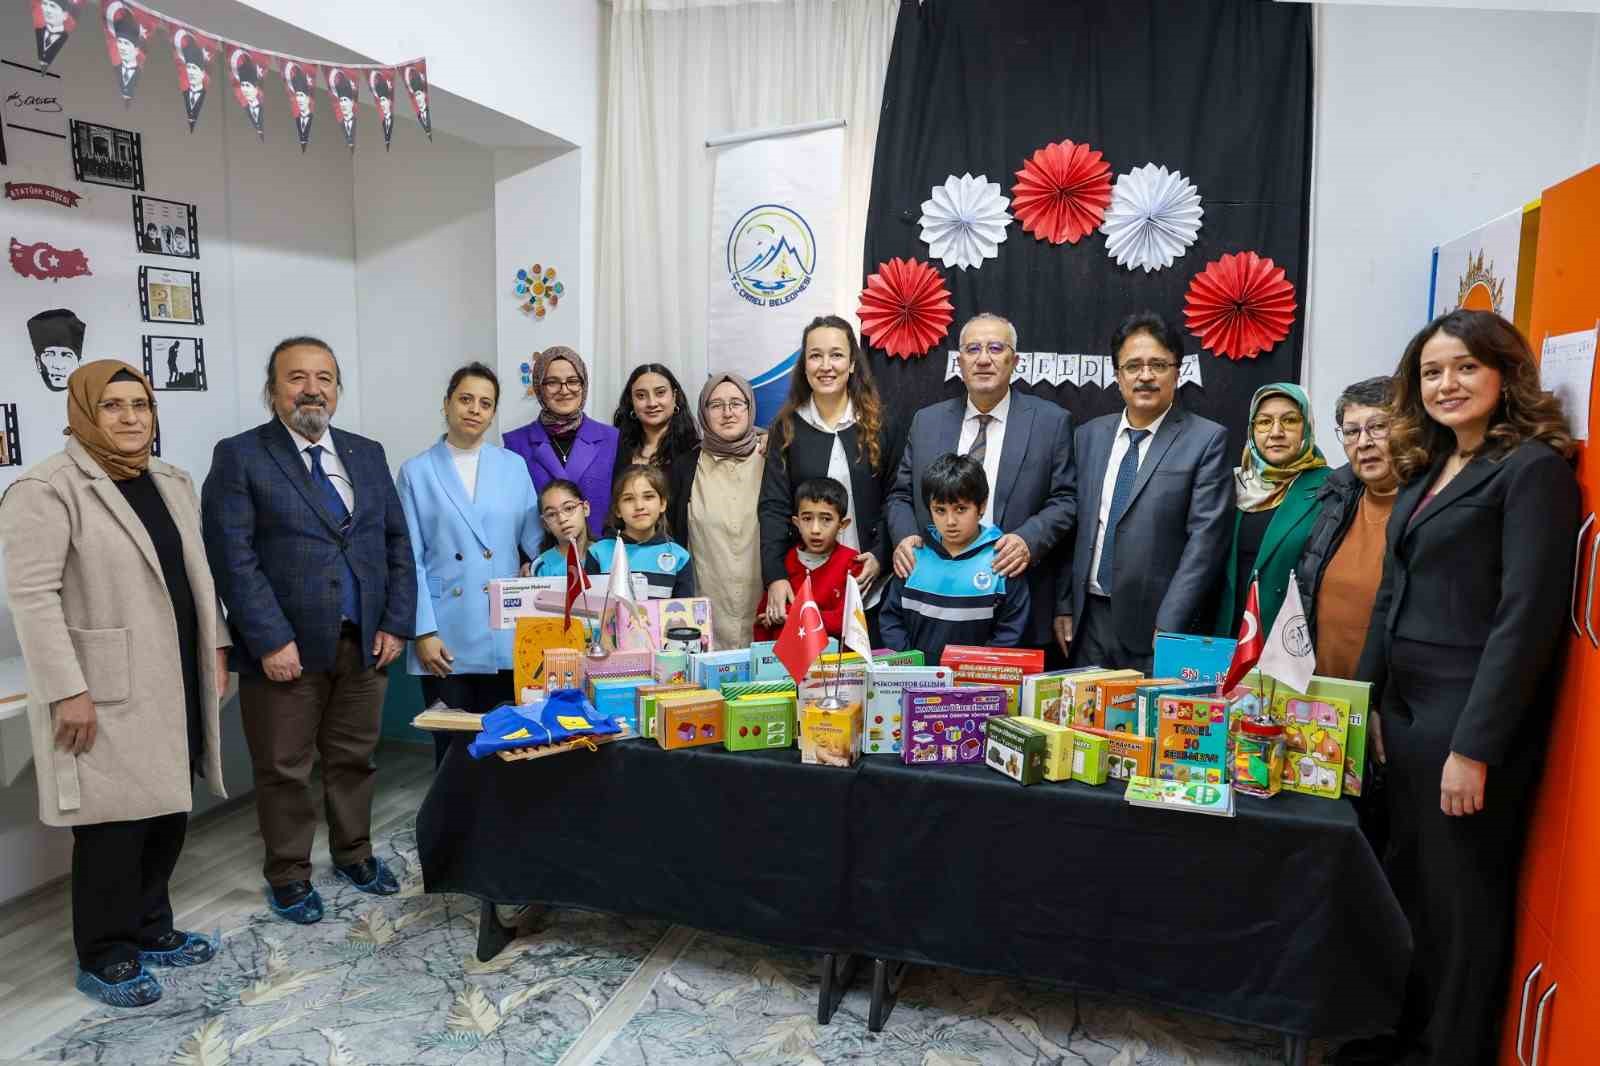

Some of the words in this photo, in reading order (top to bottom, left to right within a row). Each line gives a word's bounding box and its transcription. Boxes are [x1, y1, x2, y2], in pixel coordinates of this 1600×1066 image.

[10, 186, 44, 199] ATATÜRK
[1173, 723, 1212, 737] TEMEL
[1183, 738, 1200, 750] 50
